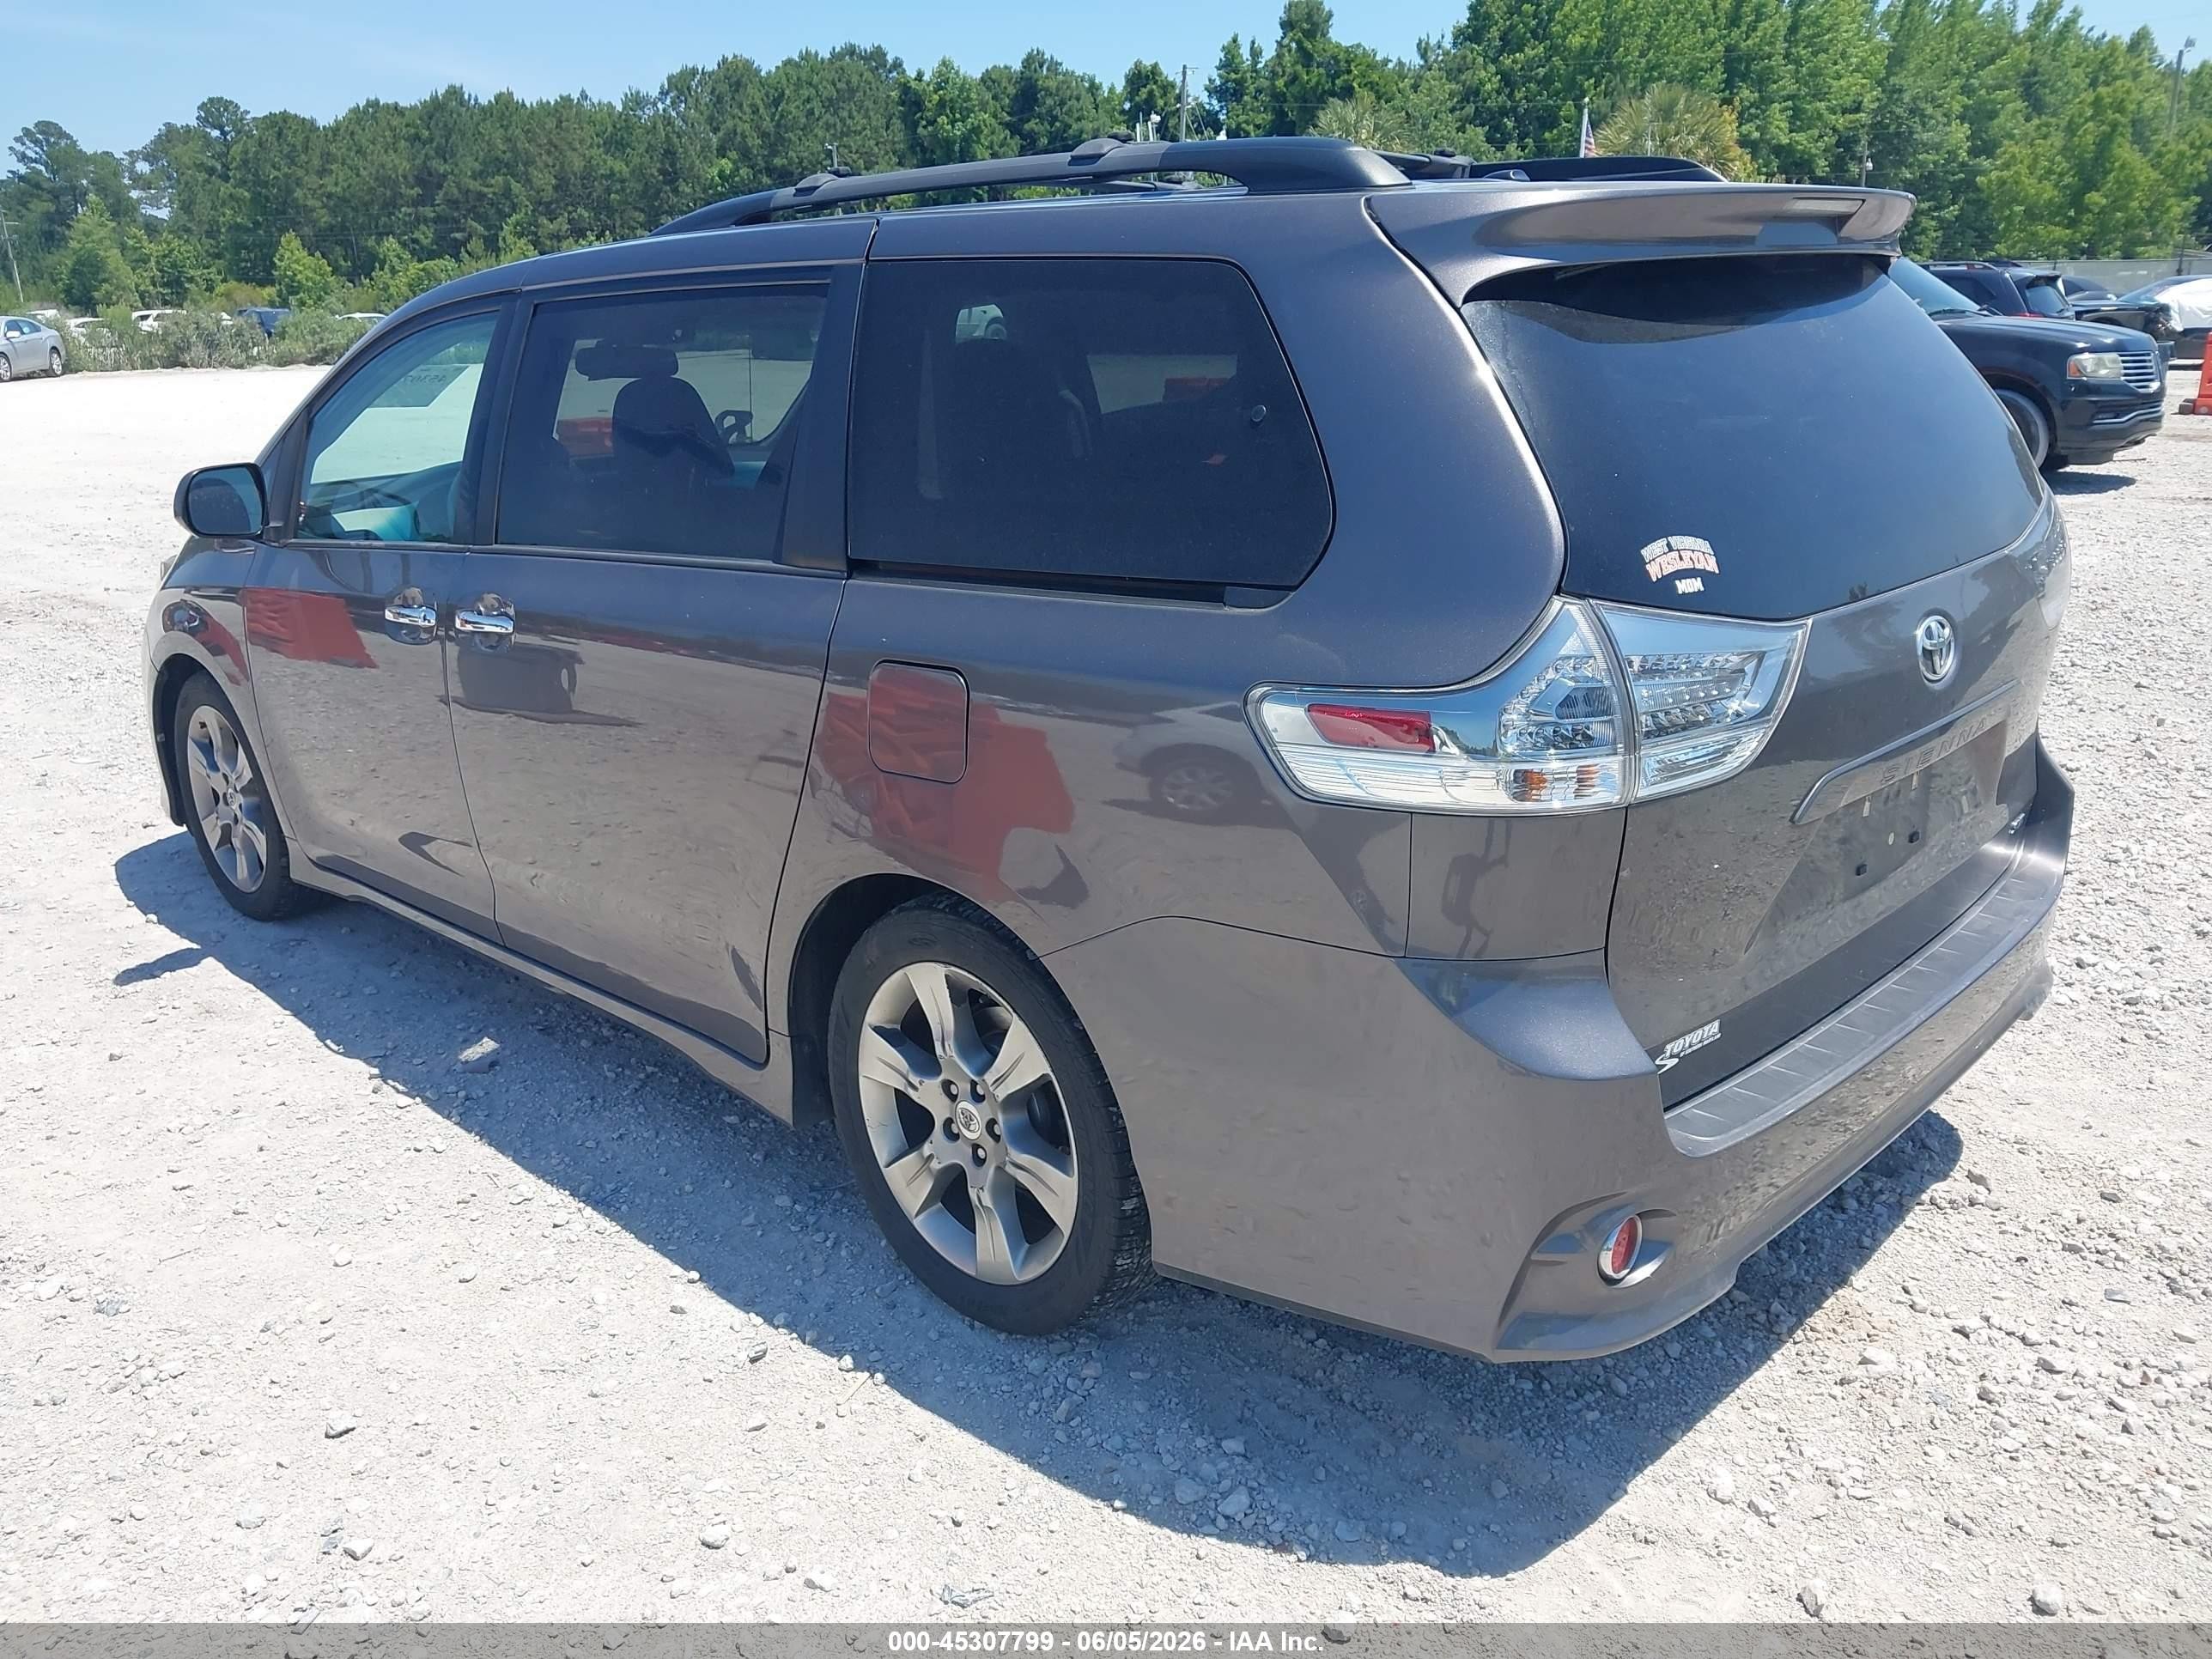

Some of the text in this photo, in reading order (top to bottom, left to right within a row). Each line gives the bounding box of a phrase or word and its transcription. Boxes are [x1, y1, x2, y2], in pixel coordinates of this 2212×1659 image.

[1641, 538, 1669, 562] WEST
[1646, 550, 1720, 582] WESLEYAN
[1674, 576, 1705, 594] MOM
[1881, 717, 1986, 783] SIENNA
[1663, 1018, 1721, 1060] TOYOTA
